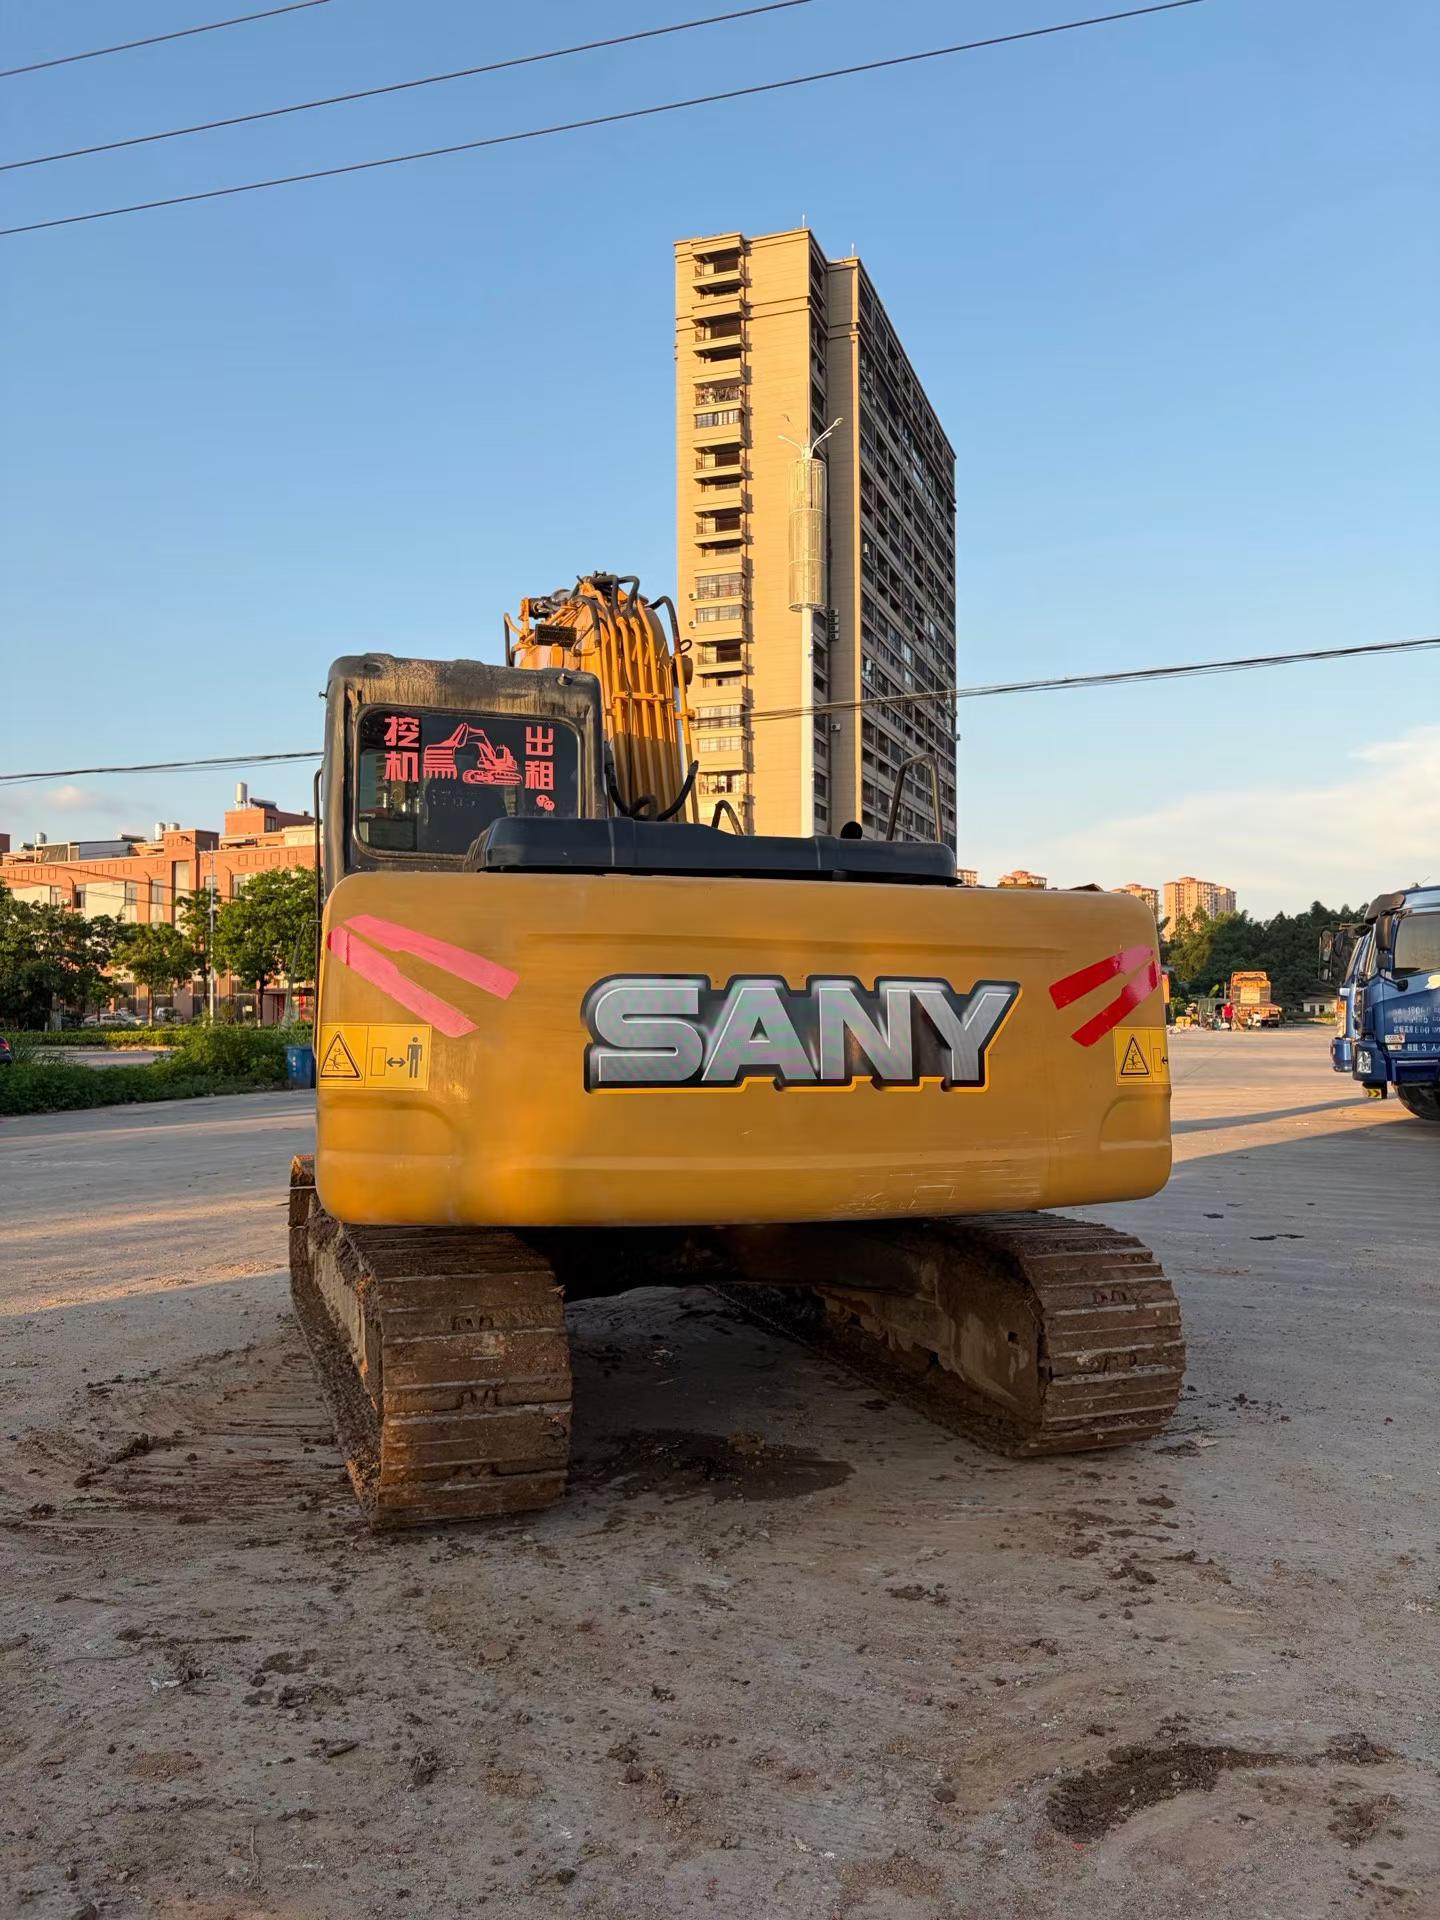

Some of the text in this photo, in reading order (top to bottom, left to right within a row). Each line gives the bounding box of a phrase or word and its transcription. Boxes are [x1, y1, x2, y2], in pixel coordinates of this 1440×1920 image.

[384, 716, 420, 782] 挖机
[525, 726, 554, 790] 出租
[584, 976, 1020, 1089] SANY
